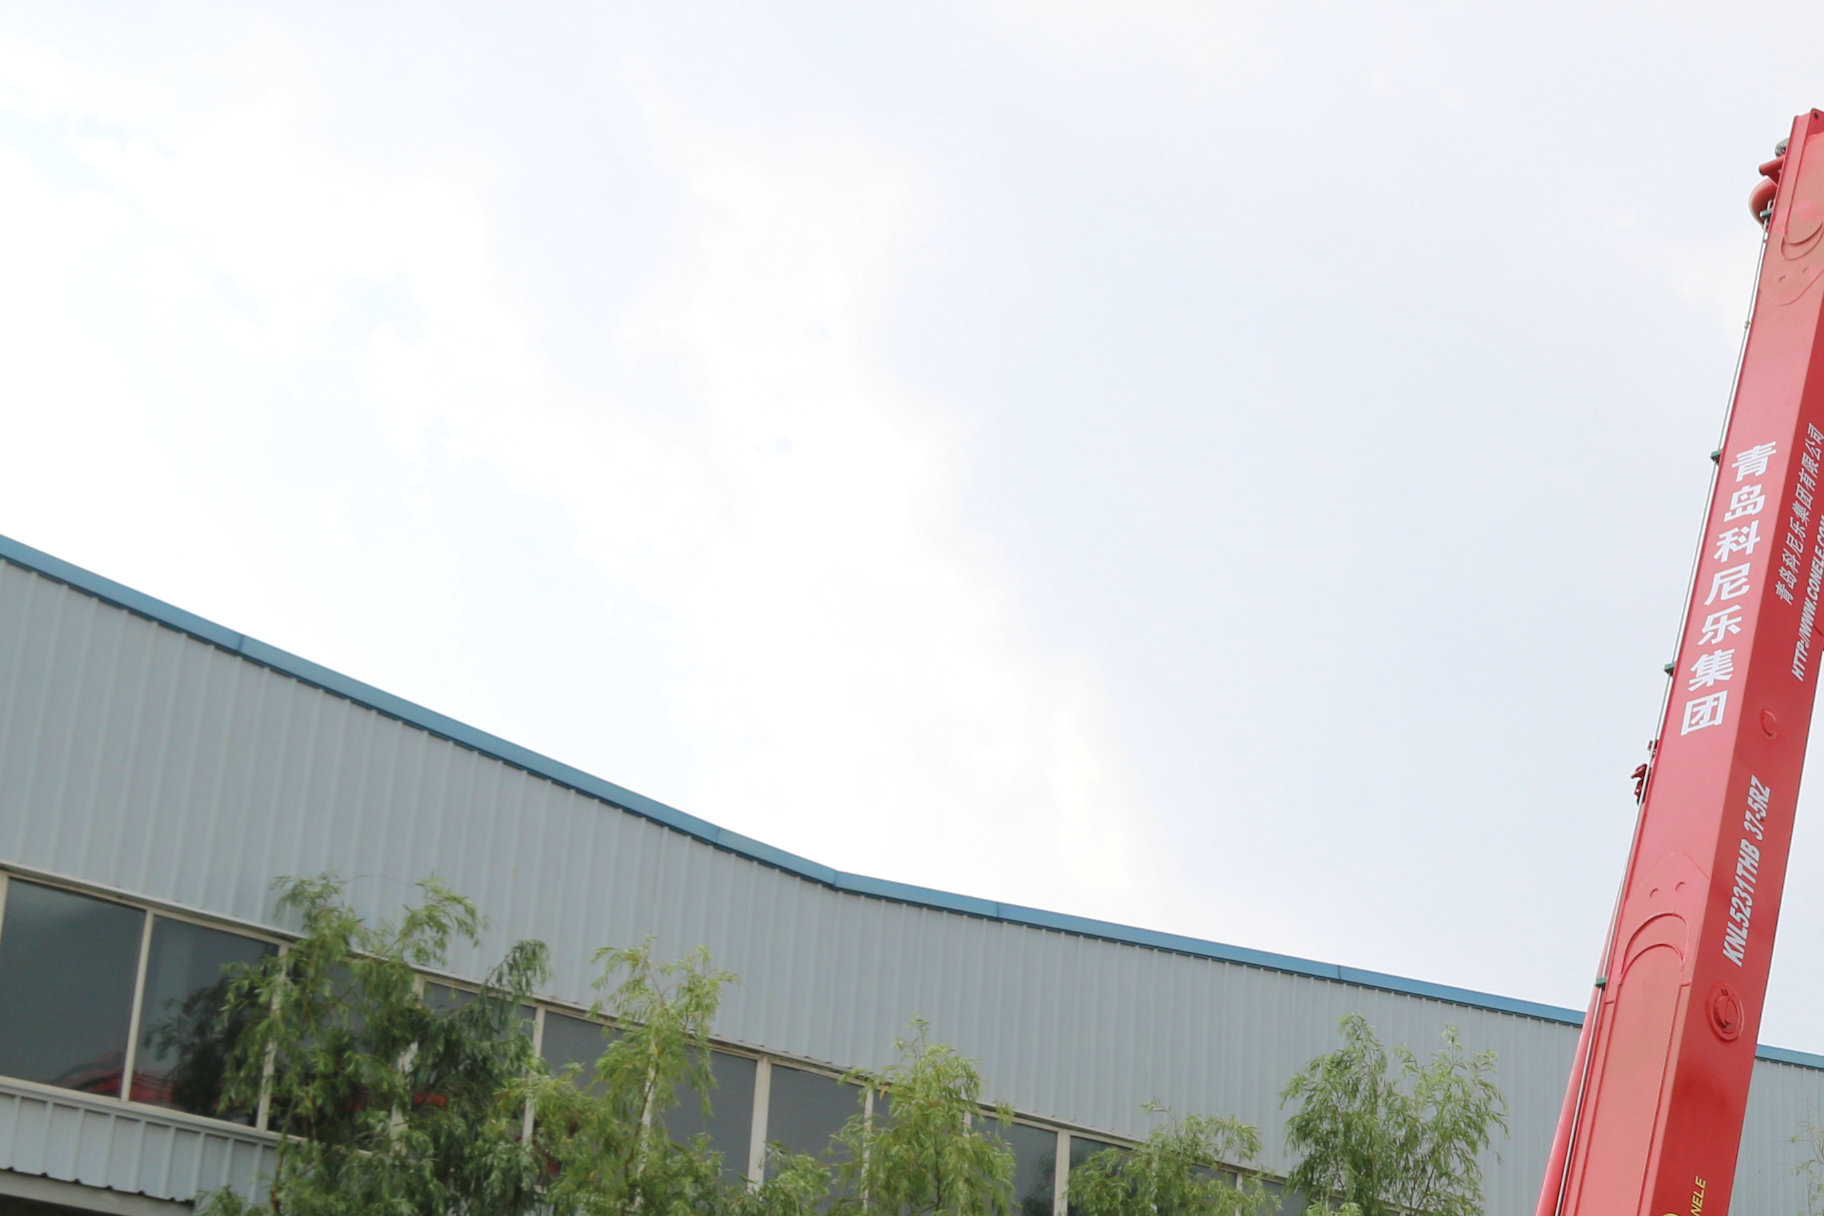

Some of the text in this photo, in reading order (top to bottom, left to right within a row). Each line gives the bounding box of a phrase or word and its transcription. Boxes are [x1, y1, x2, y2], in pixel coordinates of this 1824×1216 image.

[1680, 440, 1777, 736] 青岛科尼乐集团
[1775, 422, 1824, 606] 青岛科尼乐集团有限公司
[1722, 774, 1771, 968] KNL5231THB 37-5RZ
